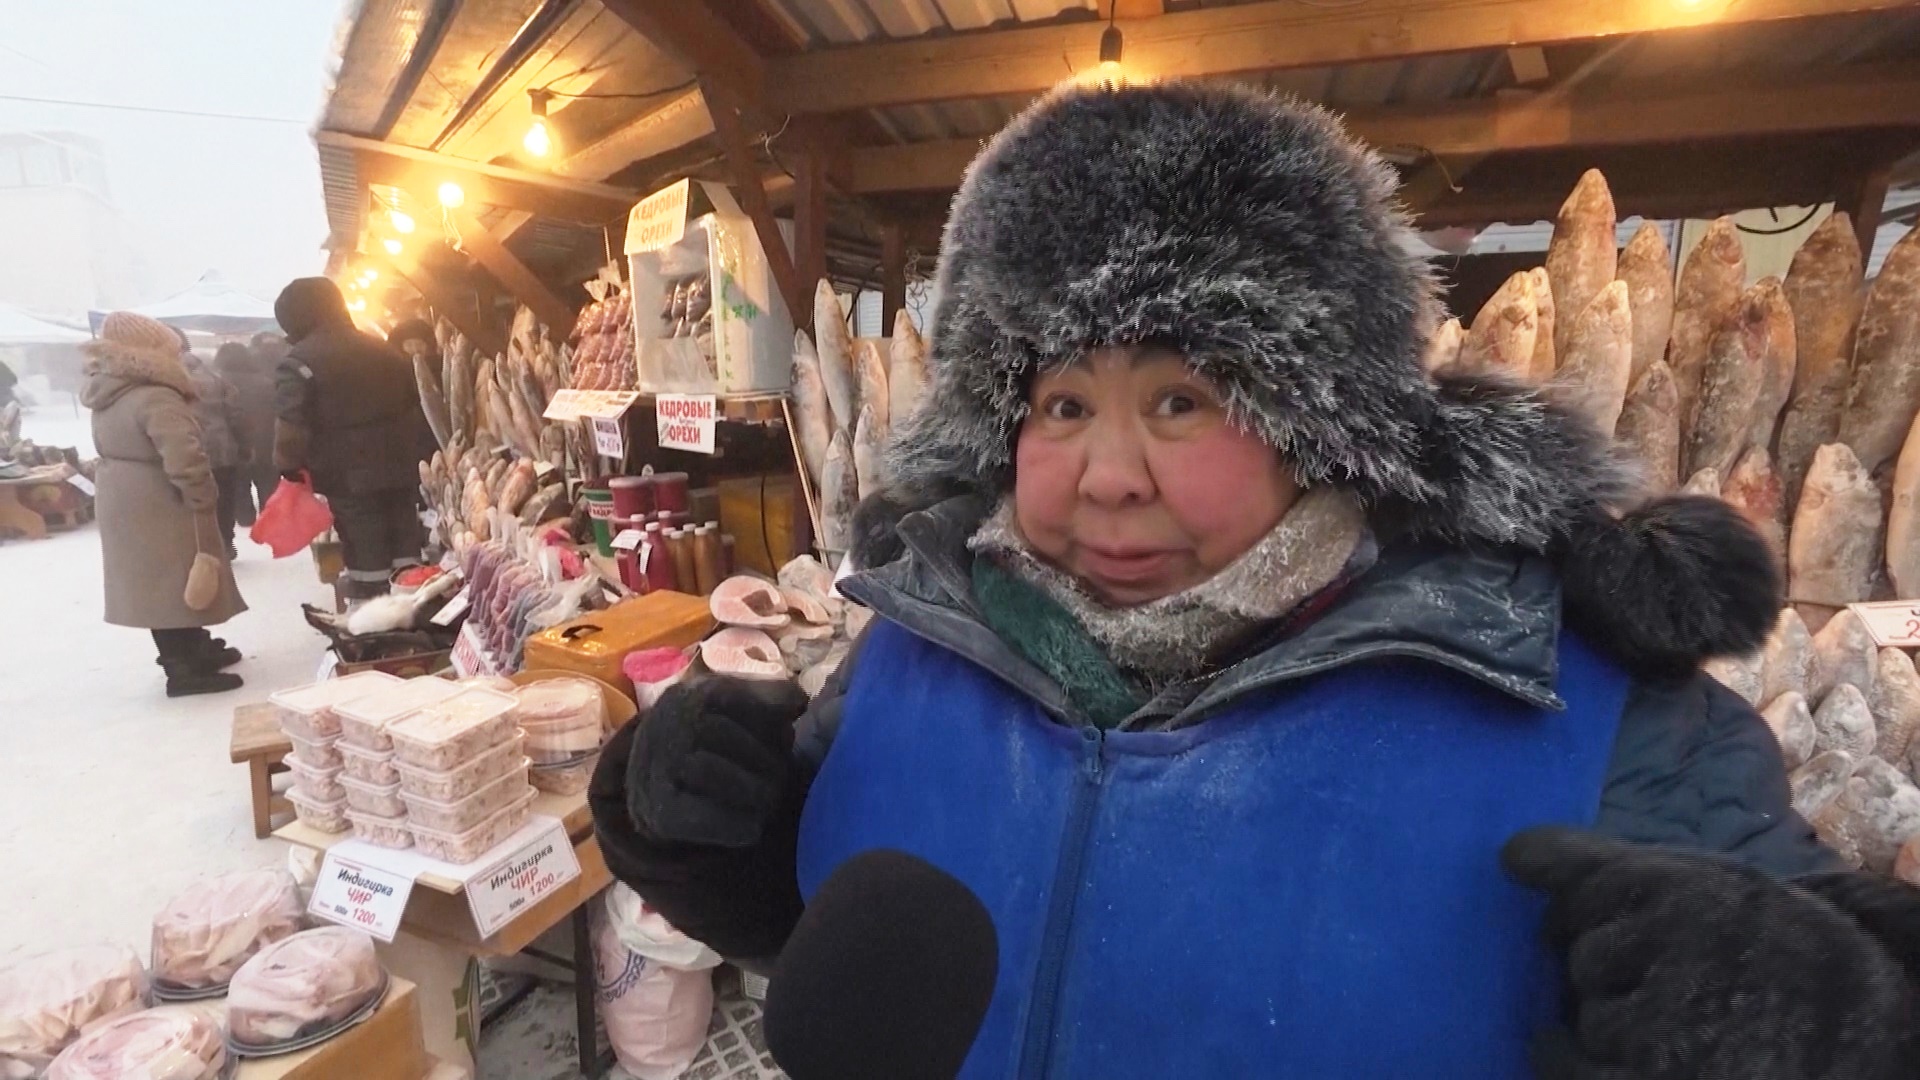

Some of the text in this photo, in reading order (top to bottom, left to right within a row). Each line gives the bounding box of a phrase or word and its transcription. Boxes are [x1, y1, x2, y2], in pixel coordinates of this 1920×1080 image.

[634, 188, 684, 221] КЕДРОВЫЕ
[642, 218, 673, 244] ОРЕХИ
[659, 400, 711, 420] КЕДРОВЫЕ
[669, 425, 701, 444] ОРЕХИ
[490, 844, 554, 891] Индигирка
[510, 866, 539, 891] ЧИР
[337, 868, 394, 897] Индигирка
[530, 872, 554, 896] 1200
[347, 887, 373, 905] ЧИР
[352, 908, 376, 925] 1200
